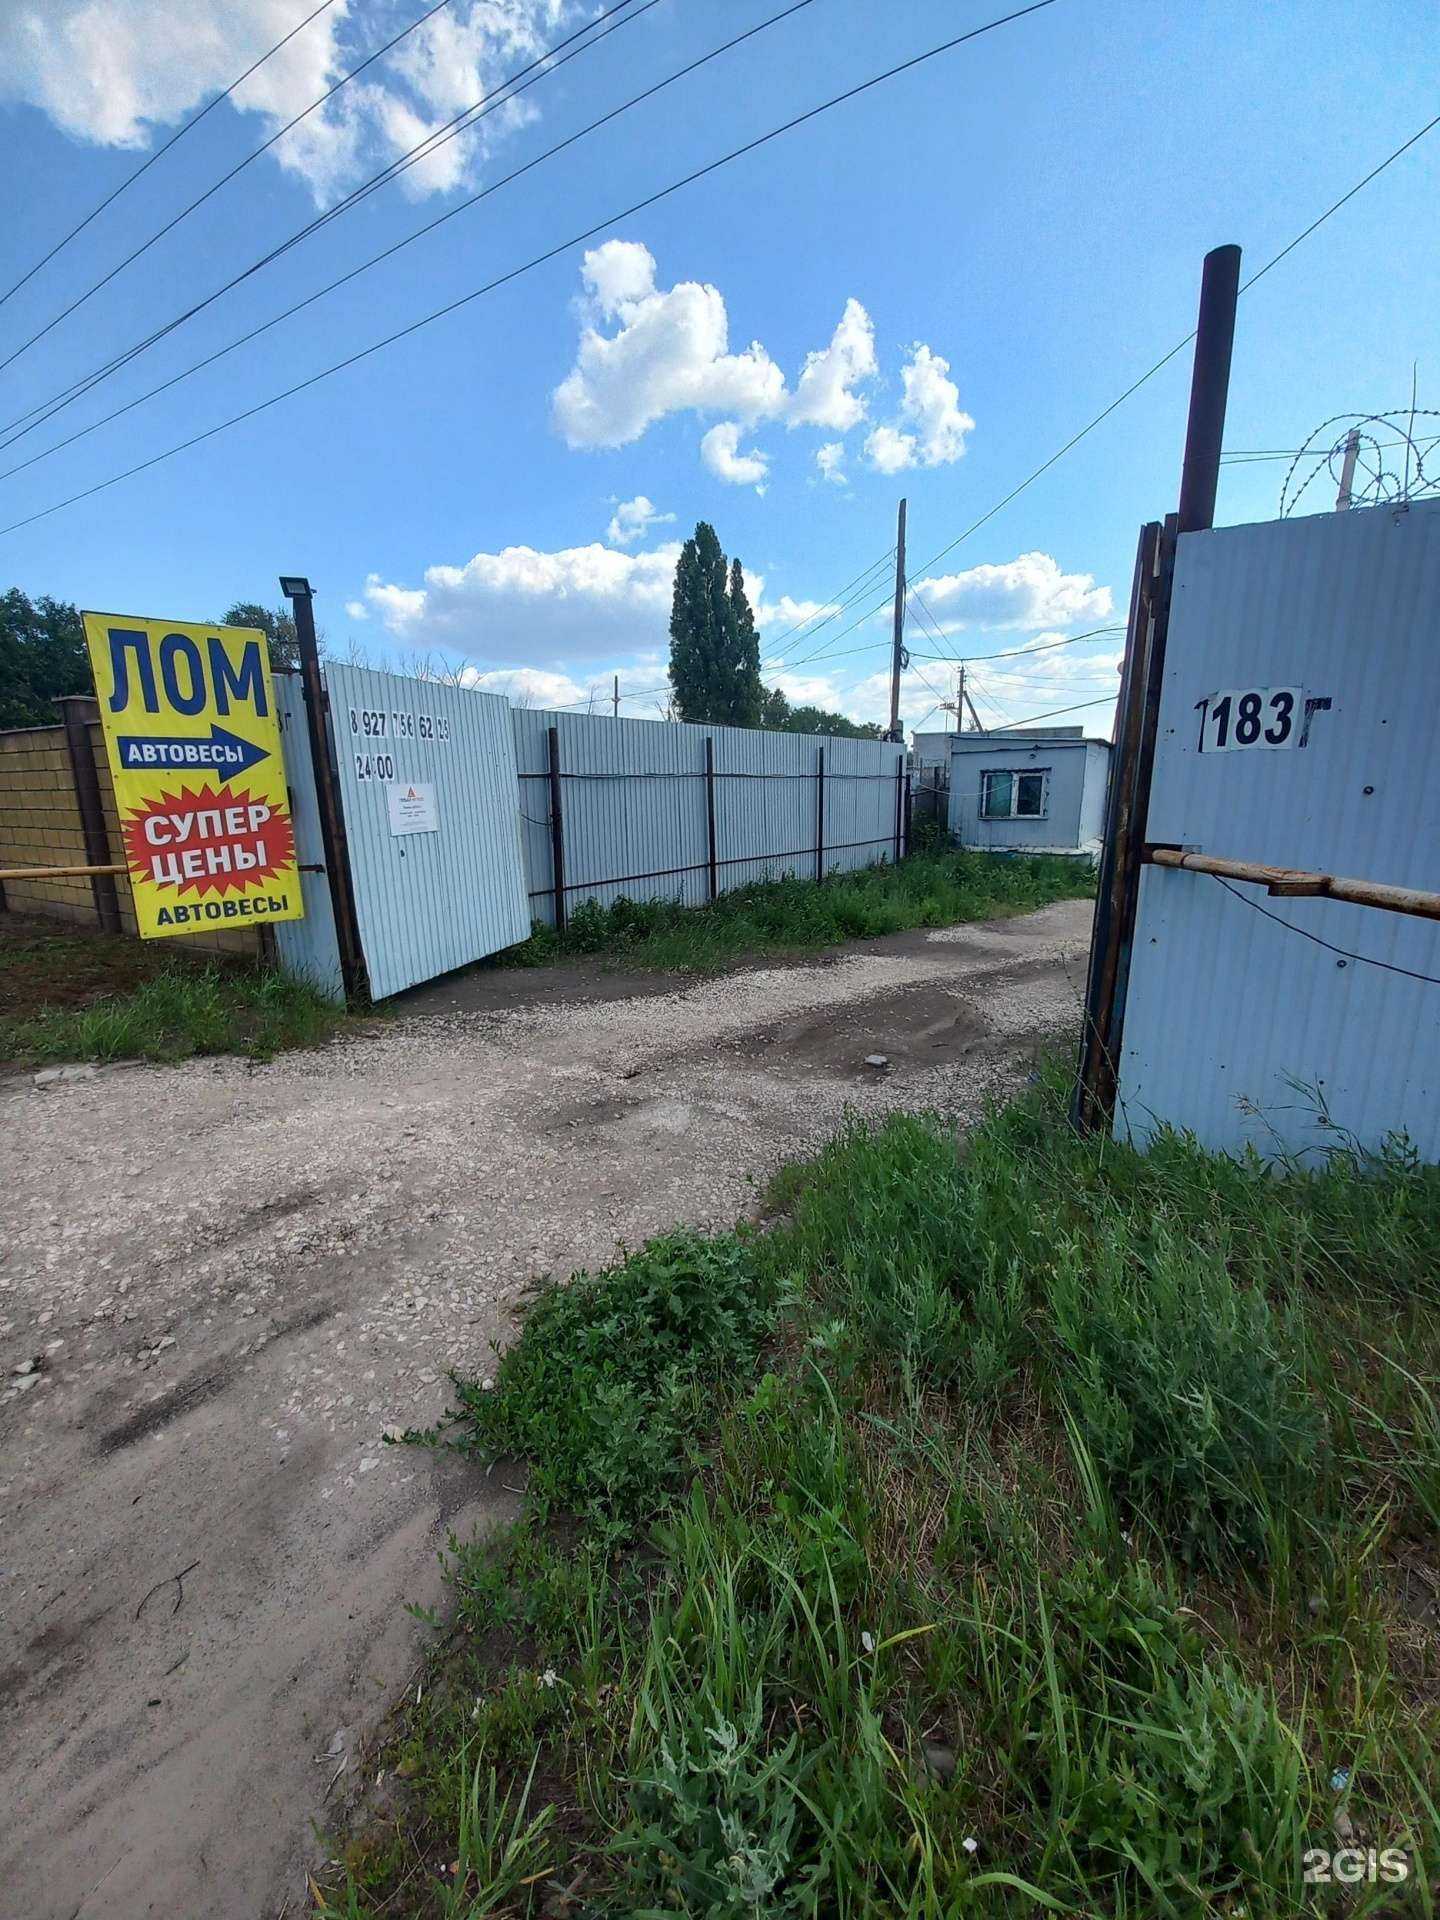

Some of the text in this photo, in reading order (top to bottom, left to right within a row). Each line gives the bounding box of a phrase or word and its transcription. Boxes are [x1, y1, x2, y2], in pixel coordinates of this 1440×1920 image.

[107, 628, 269, 717] ЛОМ
[350, 709, 358, 734] 8
[362, 711, 386, 736] 927
[419, 716, 434, 739] 62
[128, 743, 244, 763] АВТОВЕСЫ
[144, 804, 271, 846] СУПЕР
[151, 840, 267, 885] ЦЕНЫ
[156, 895, 288, 926] АВТОВЕСЫ
